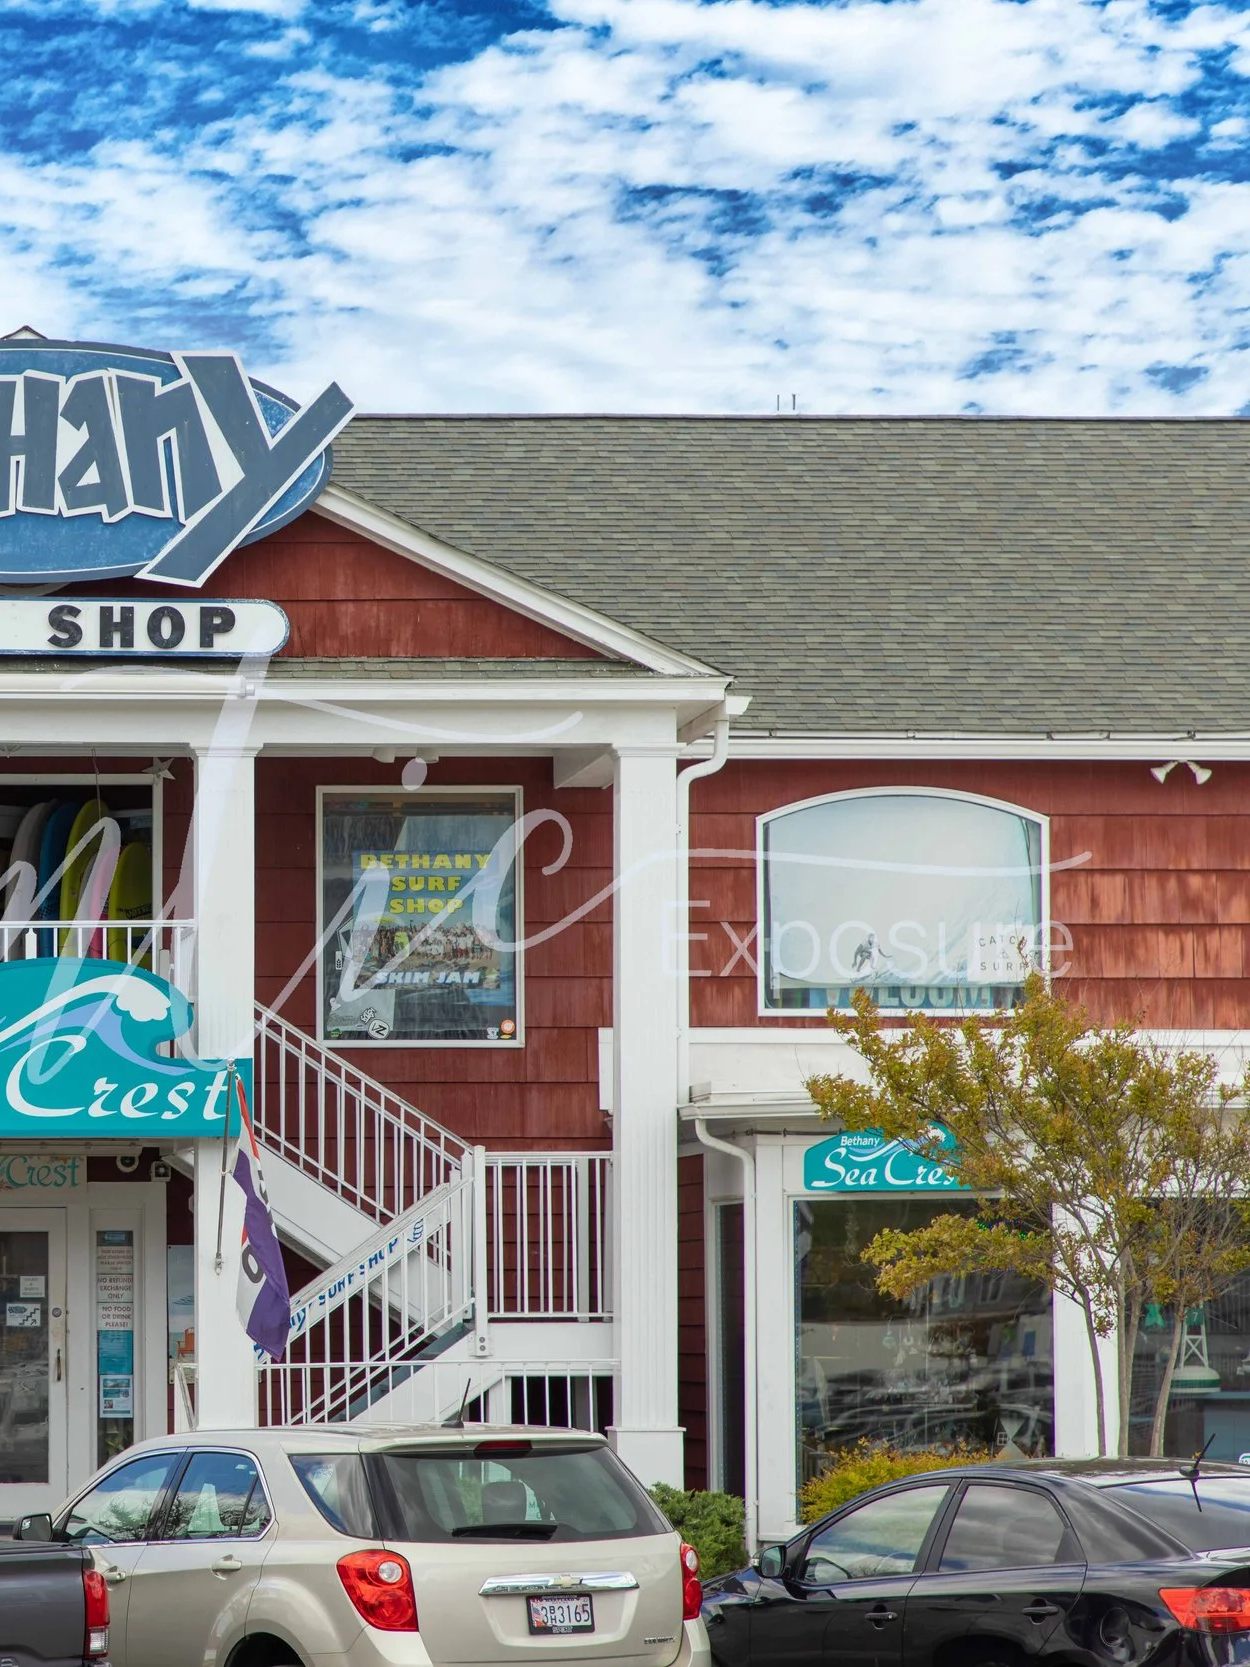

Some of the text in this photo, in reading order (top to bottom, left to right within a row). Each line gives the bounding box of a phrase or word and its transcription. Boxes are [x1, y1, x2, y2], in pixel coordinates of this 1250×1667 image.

[47, 604, 236, 648] SHOP
[360, 854, 491, 869] BETHANY
[391, 876, 462, 891] SURF
[390, 898, 463, 913] SHOP
[373, 971, 481, 984] SKIM JAM
[5, 1035, 228, 1121] Crest
[840, 1135, 880, 1147] Bethany
[6, 1155, 80, 1188] Crest
[811, 1147, 878, 1187] Sea
